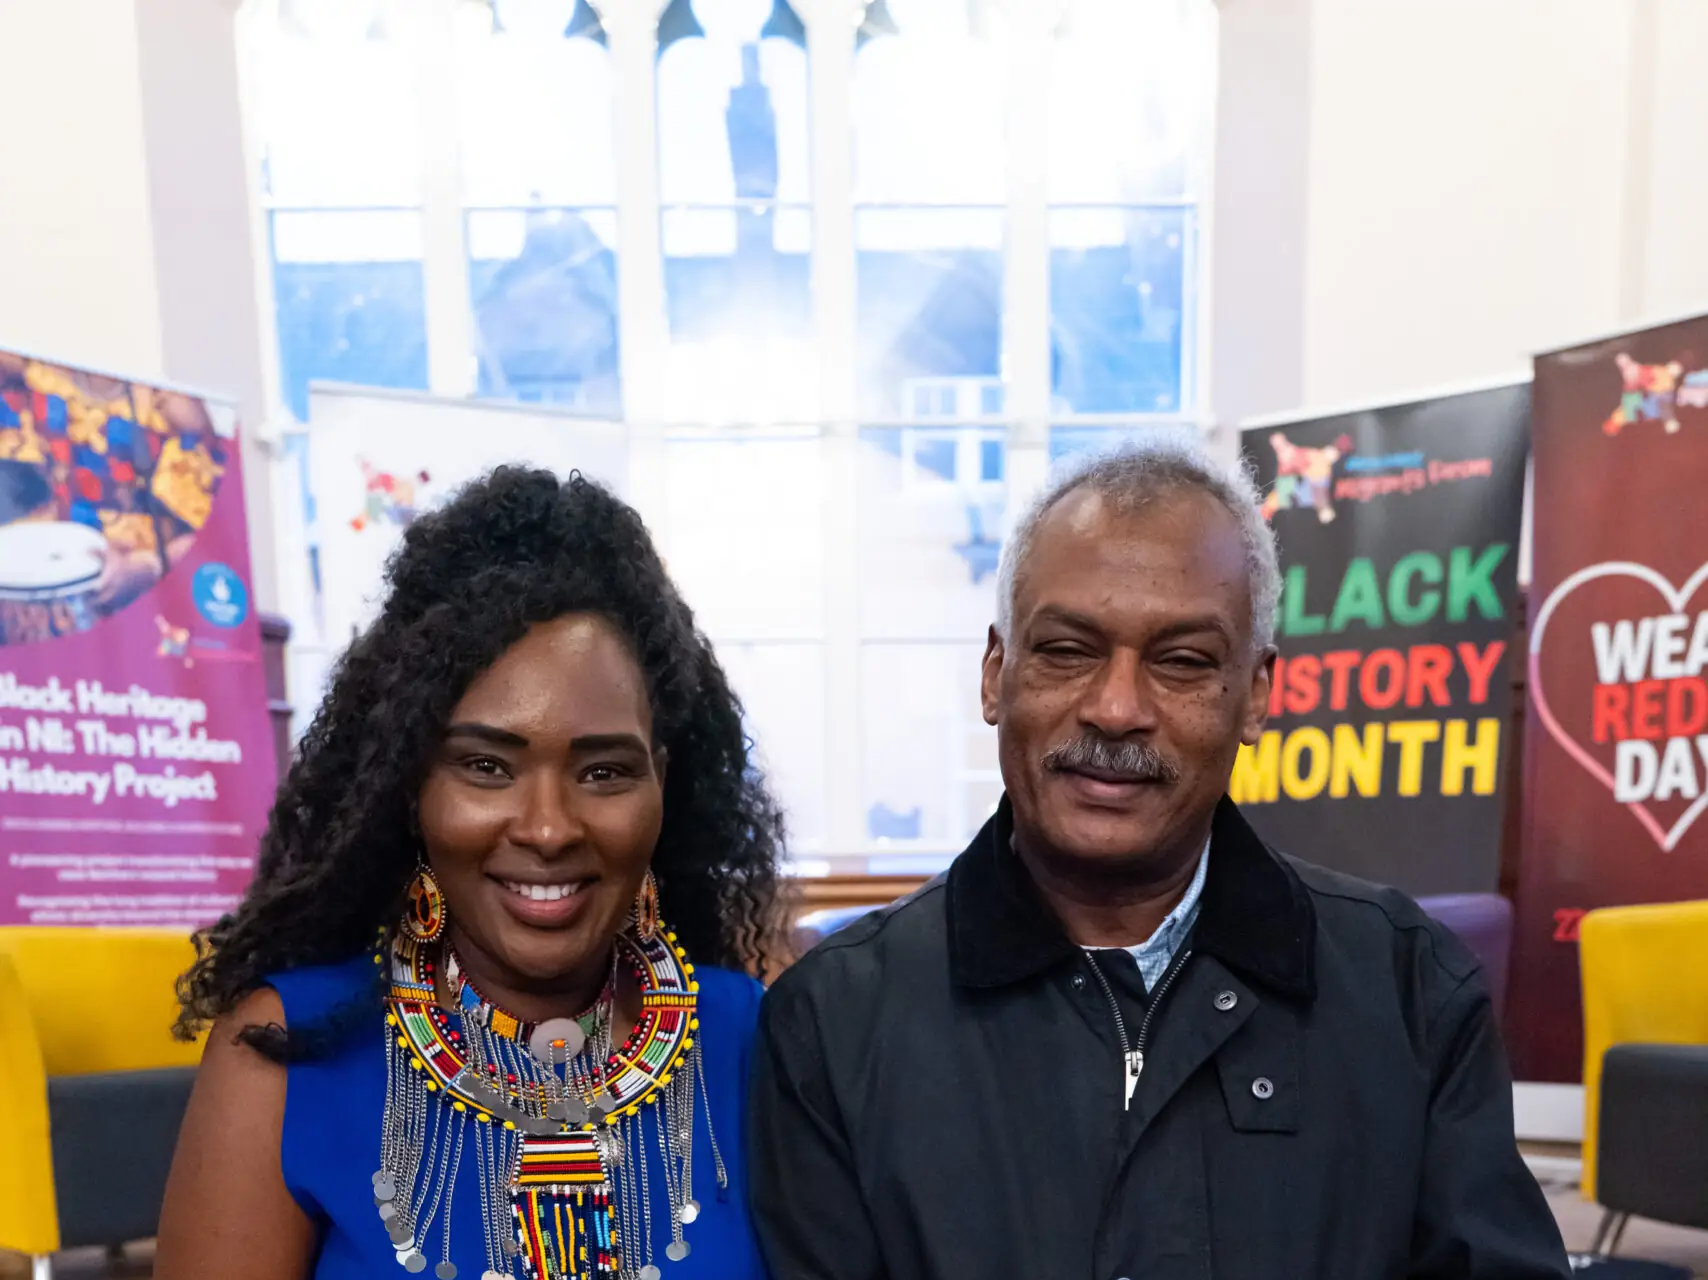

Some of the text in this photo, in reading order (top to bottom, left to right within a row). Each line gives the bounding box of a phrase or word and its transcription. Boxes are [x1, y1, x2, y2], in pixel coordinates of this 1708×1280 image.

[1275, 544, 1509, 637] LACK
[0, 671, 207, 729] lack Heritage
[1267, 641, 1506, 718] ISTORY
[1593, 675, 1708, 743] RED
[0, 717, 25, 751] n
[75, 720, 136, 758] The
[137, 724, 242, 764] Hidden
[1230, 718, 1499, 804] MONTH
[112, 761, 218, 808] Project
